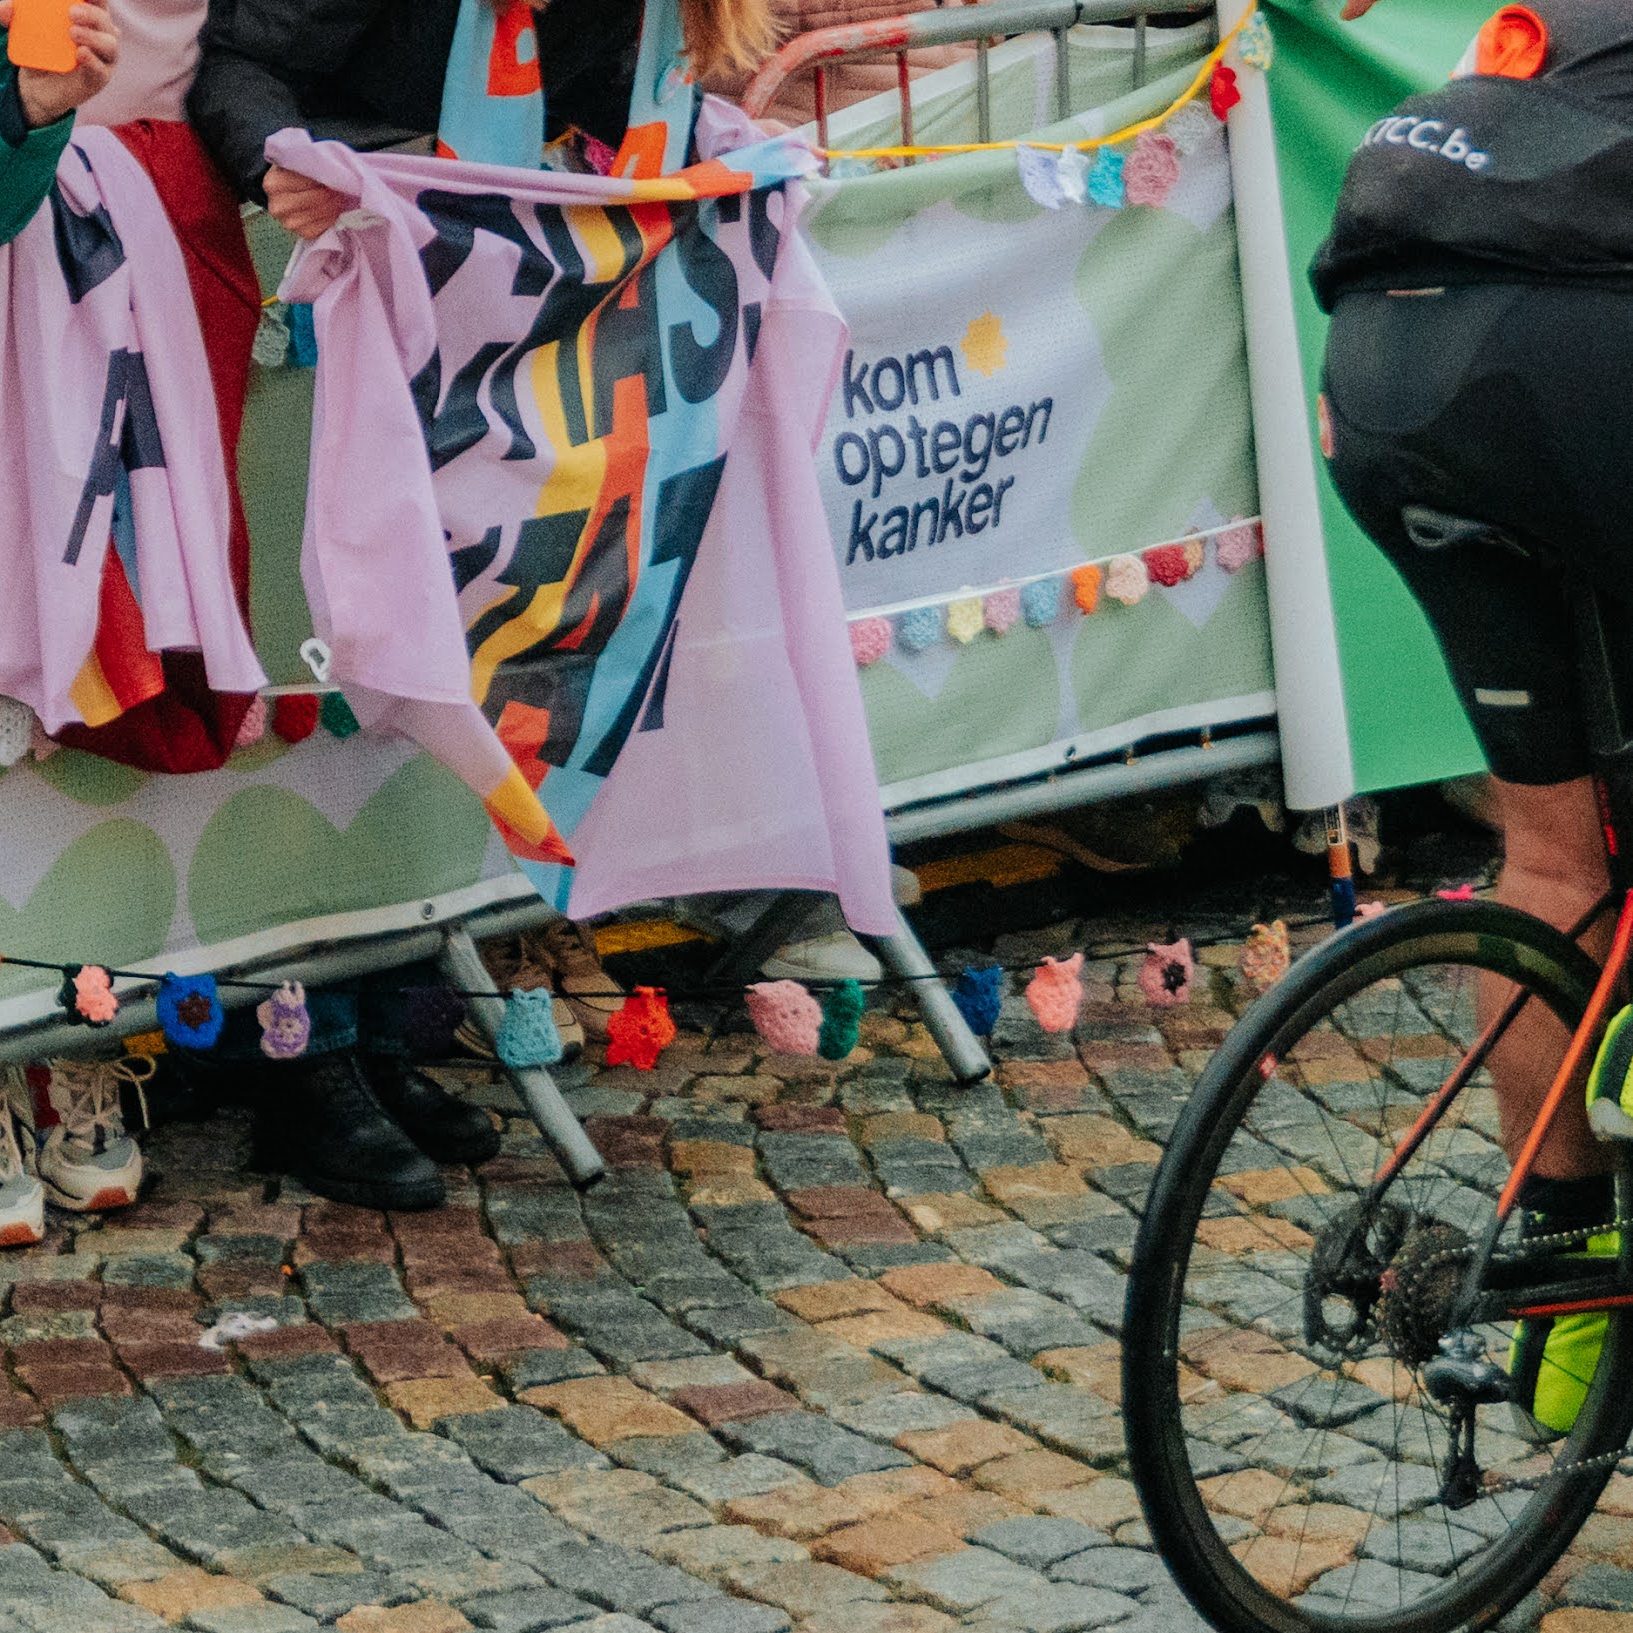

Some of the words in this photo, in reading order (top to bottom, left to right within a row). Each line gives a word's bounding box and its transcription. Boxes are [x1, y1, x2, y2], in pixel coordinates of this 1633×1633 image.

[842, 345, 960, 418] kom
[833, 424, 906, 498] op
[906, 397, 1053, 483] tegen
[845, 475, 1015, 566] kanker
